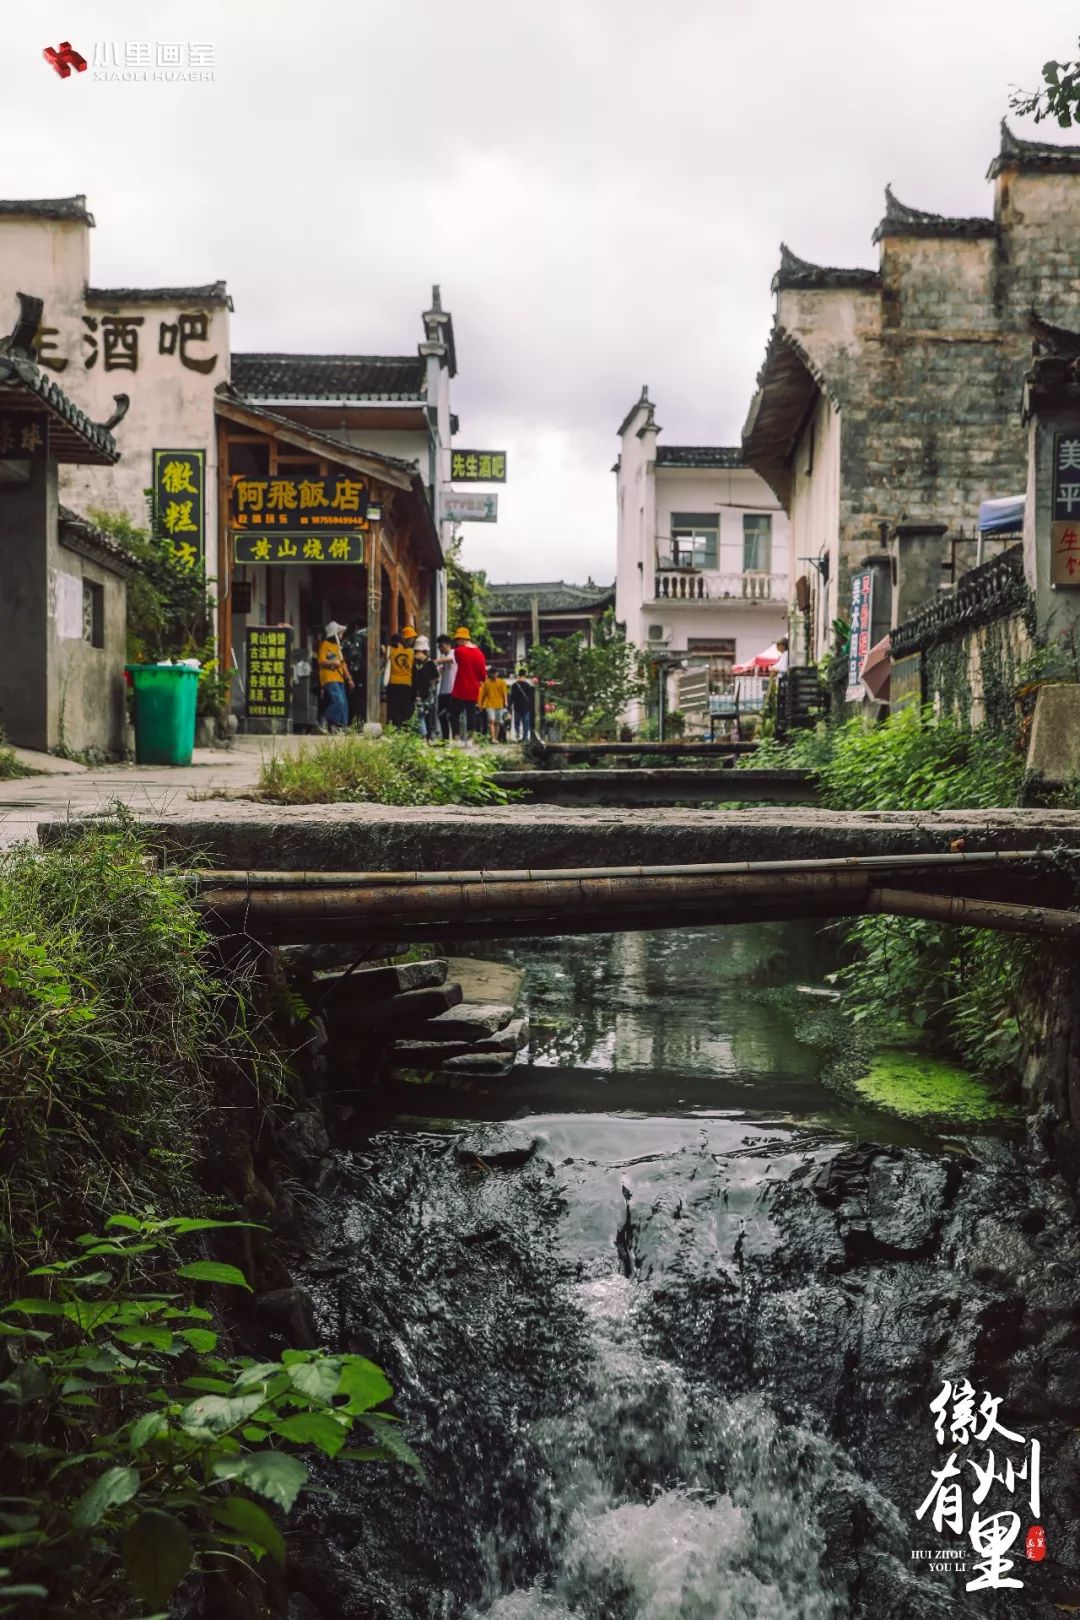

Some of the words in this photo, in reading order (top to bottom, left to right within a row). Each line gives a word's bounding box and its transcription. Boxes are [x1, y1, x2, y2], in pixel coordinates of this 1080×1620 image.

[452, 454, 505, 478] 先生酒吧
[237, 480, 363, 512] 阿飛飯店
[250, 536, 352, 561] 黄山烧饼
